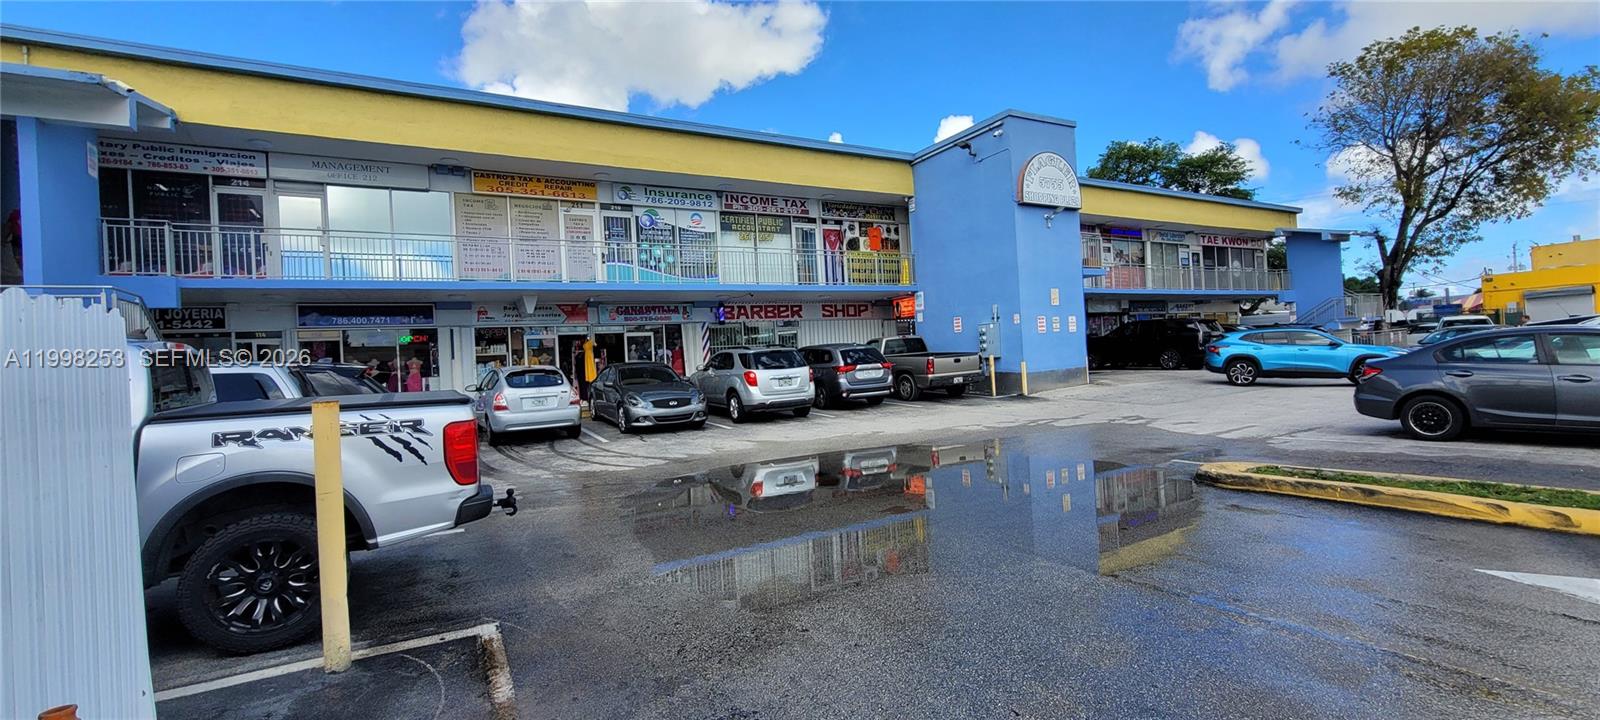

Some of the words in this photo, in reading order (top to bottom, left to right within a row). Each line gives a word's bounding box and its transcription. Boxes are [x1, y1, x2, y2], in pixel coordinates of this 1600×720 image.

[133, 143, 175, 154] Public
[180, 147, 256, 161] Inmigracion
[143, 152, 200, 164] Creditos
[216, 158, 255, 168] Viajes
[312, 160, 391, 174] MANAGEMENT
[327, 172, 358, 180] OFFICE
[362, 174, 378, 182] 212
[474, 171, 515, 181] CASTRO'S
[518, 175, 539, 183] TAX
[549, 178, 596, 188] ACCOUNTING
[487, 185, 587, 200] 305-351-6613
[549, 184, 574, 192] REPAIR
[644, 187, 713, 201] Insurance
[645, 197, 713, 208] 786-209-9812
[725, 193, 778, 207] INCOME
[782, 199, 807, 209] TAX
[721, 215, 755, 224] CERTIFIED
[758, 217, 784, 227] PUBLIC
[1200, 234, 1219, 245] TAE
[1222, 236, 1249, 247] KWON
[164, 308, 224, 320] JOYERIA
[725, 303, 803, 319] BARBER
[822, 303, 869, 318] SHOP
[332, 316, 392, 325] 786.400.7471
